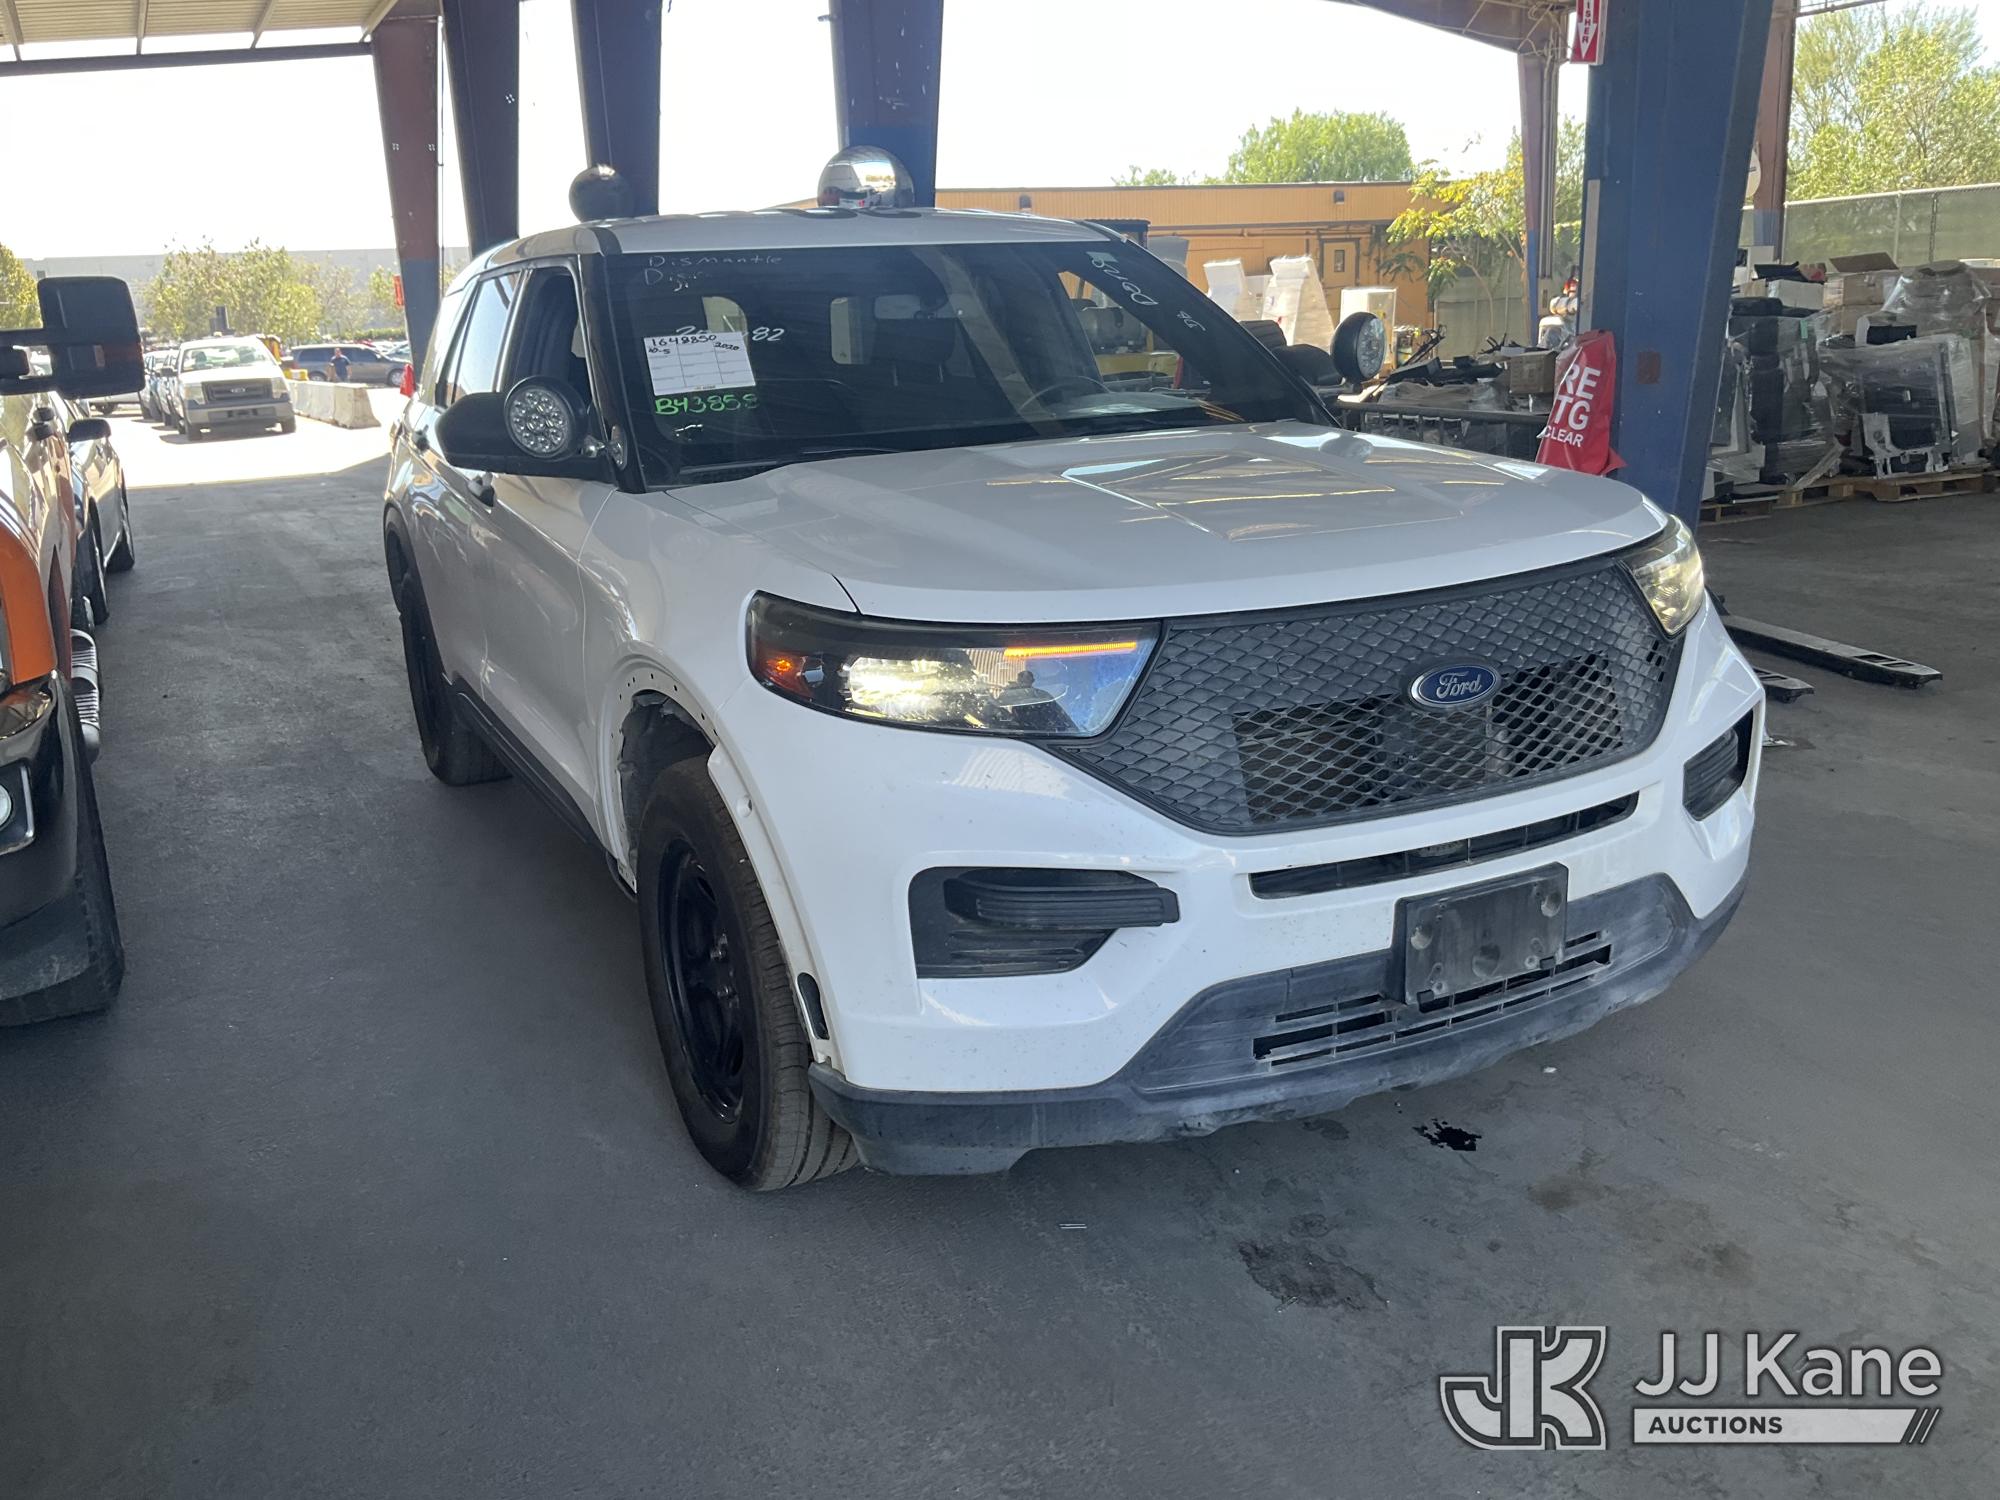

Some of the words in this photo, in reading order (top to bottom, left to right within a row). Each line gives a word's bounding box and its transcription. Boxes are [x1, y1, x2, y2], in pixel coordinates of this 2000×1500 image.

[649, 254, 782, 267] Dismantle
[1543, 425, 1584, 448] CLEAR
[1436, 671, 1482, 698] Ford
